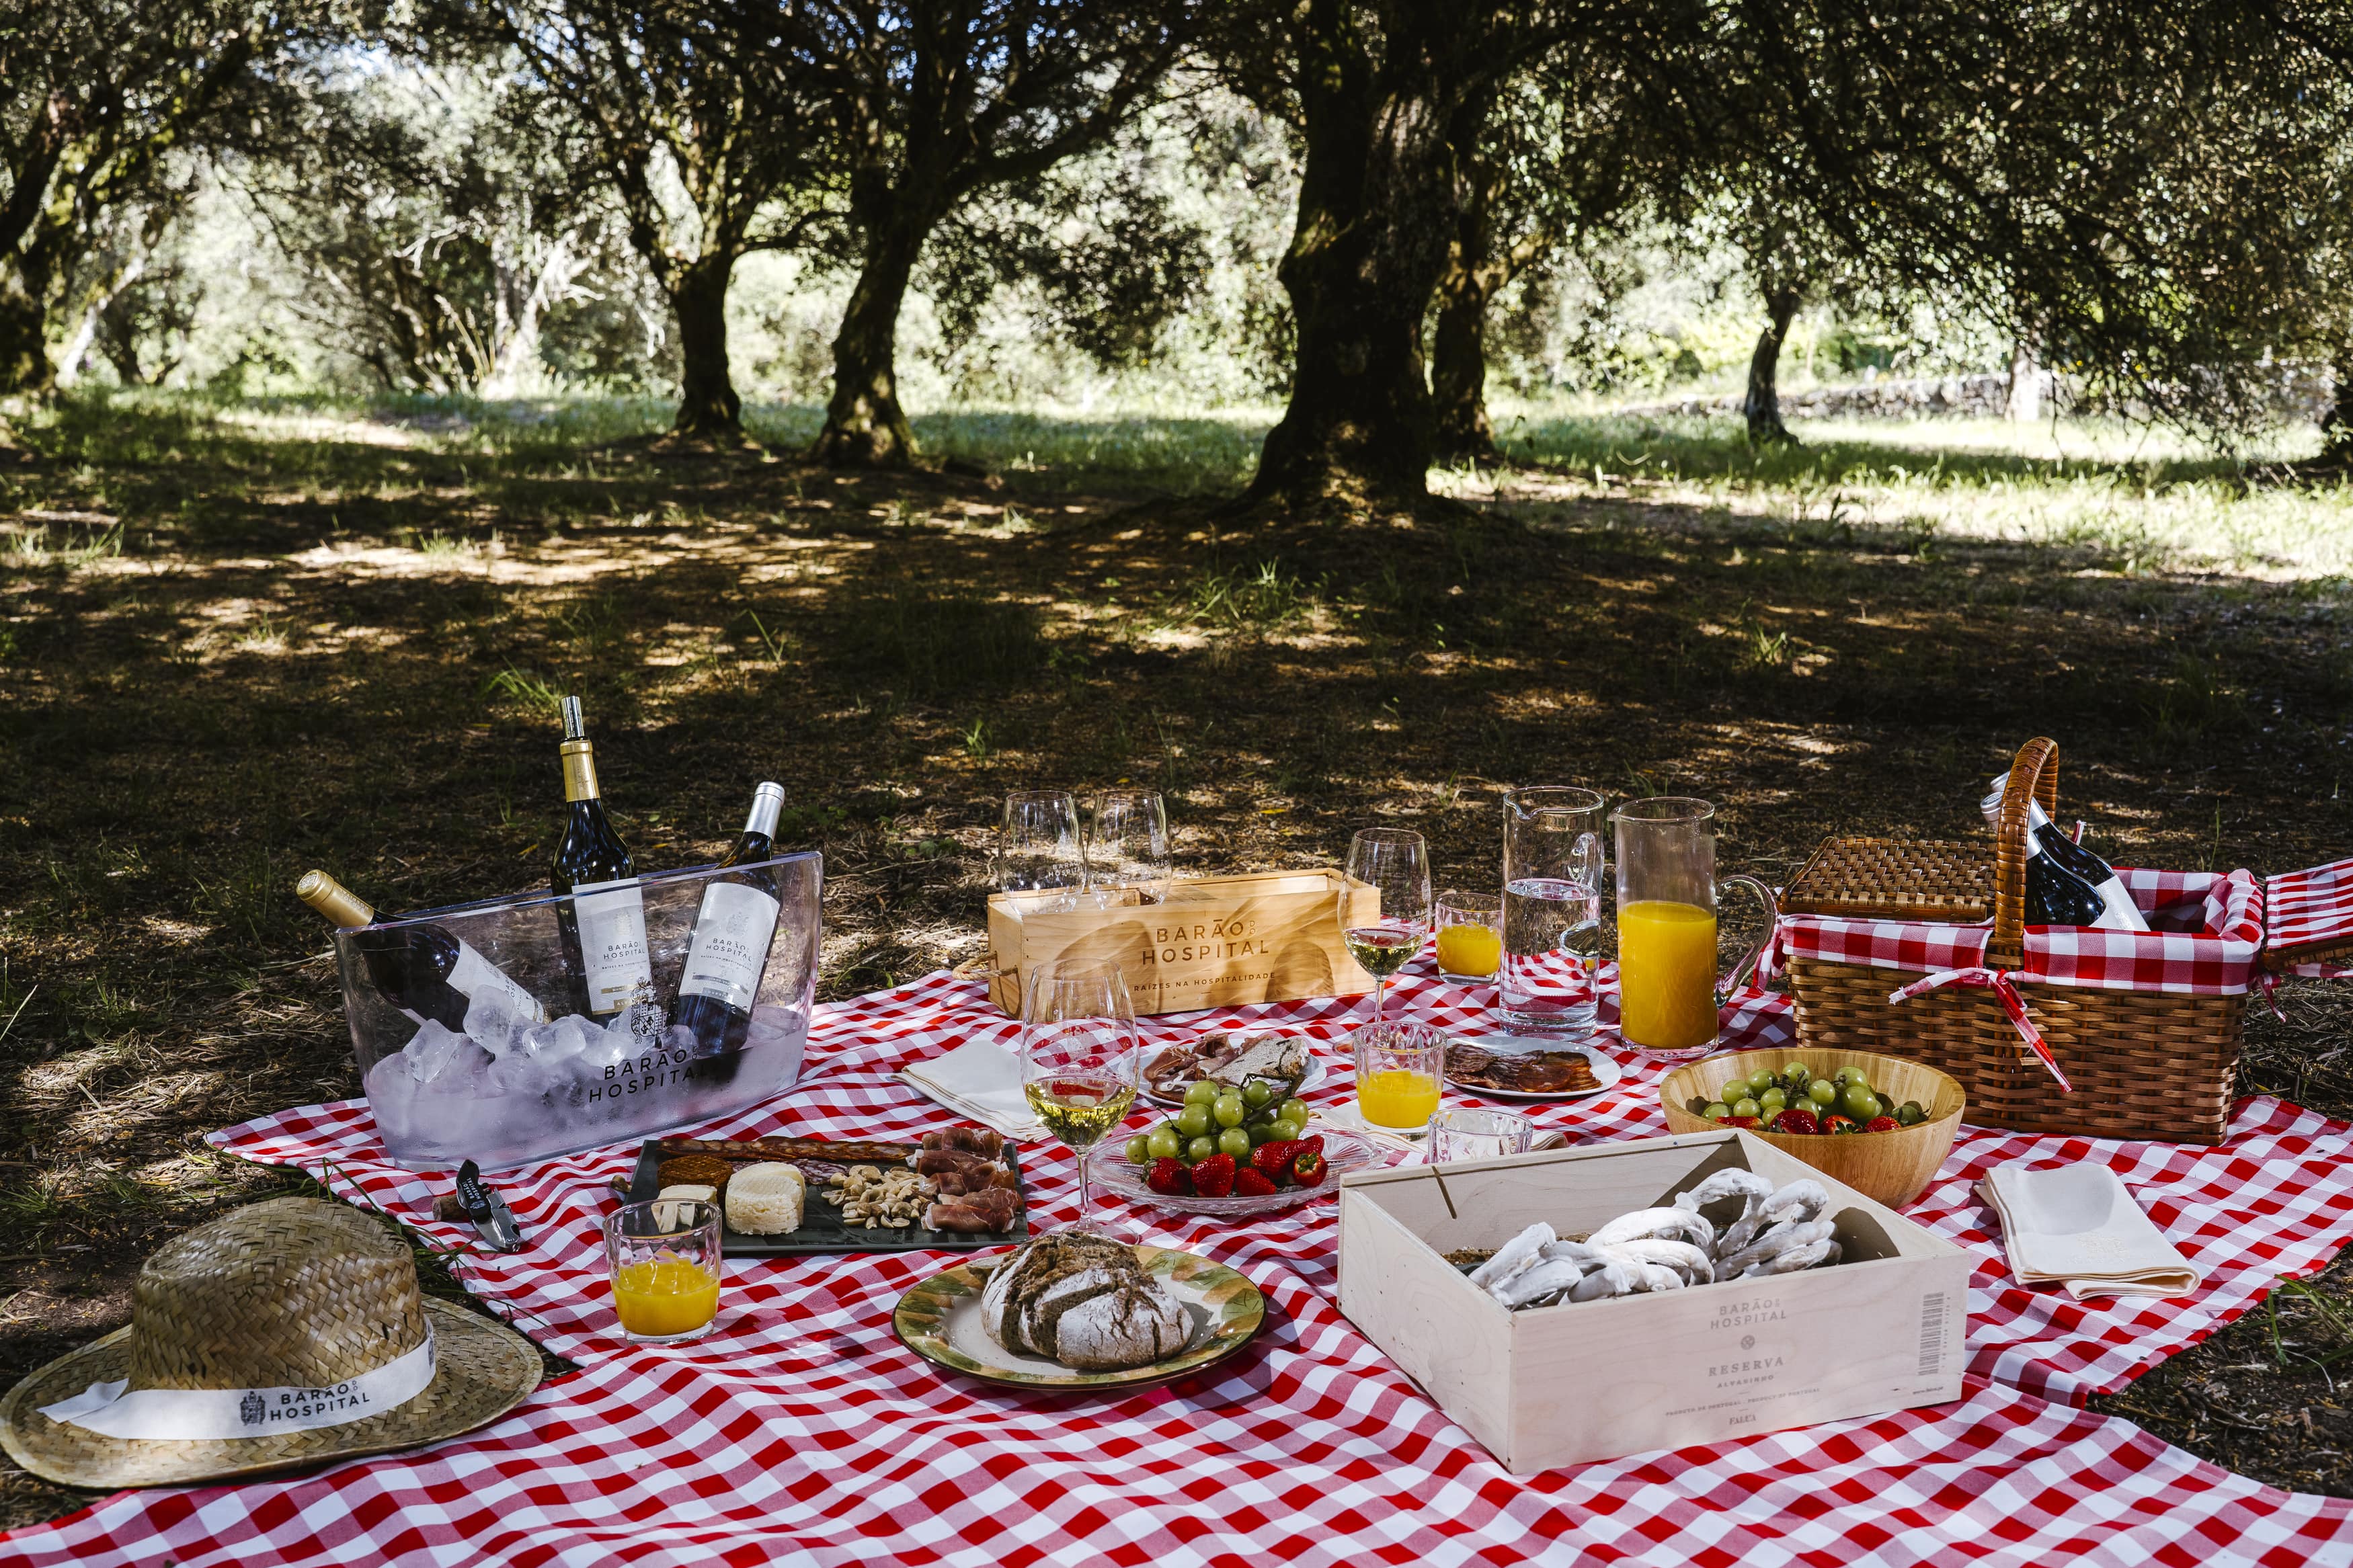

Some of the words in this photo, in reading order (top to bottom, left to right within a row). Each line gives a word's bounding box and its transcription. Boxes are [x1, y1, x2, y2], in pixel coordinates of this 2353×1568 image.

[1156, 919, 1244, 943] BARÃO
[603, 948, 645, 960] HOSPITAL
[608, 941, 639, 952] BARÃO
[1142, 940, 1269, 964] HOSPITAL
[1134, 983, 1170, 991] RAÍZES
[1194, 973, 1275, 985] HOSPITALIDADE
[604, 1048, 687, 1080] BARÃO
[467, 1178, 481, 1199] HOSPITAL
[1719, 1298, 1773, 1315] BARÃO
[1710, 1309, 1786, 1329] HOSPITAL
[1708, 1356, 1784, 1376] RESERVA
[1716, 1374, 1773, 1389] ALVARINHO
[280, 1384, 349, 1405] BARÃO
[270, 1392, 370, 1421] HOSPITAL
